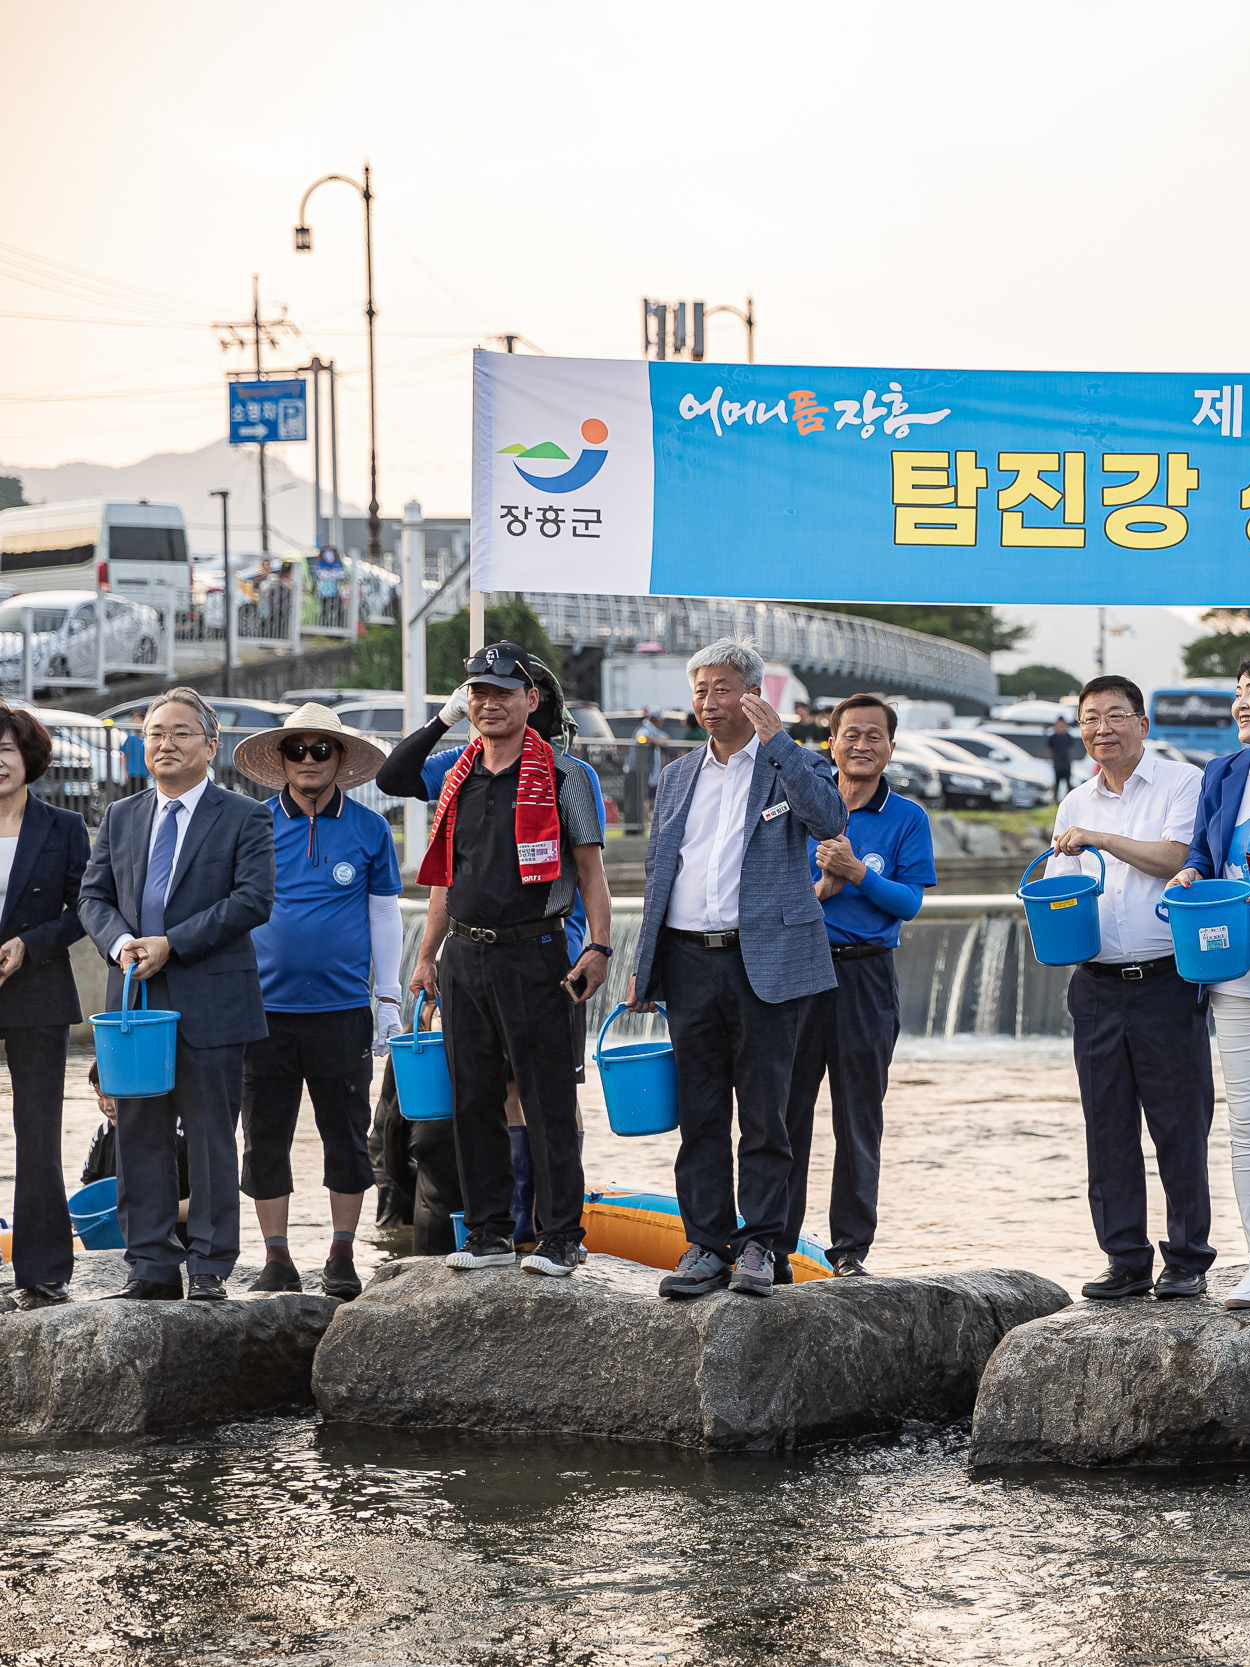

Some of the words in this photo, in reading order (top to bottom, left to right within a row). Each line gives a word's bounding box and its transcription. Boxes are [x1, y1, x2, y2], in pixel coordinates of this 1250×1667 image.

[833, 381, 952, 440] 장흥
[499, 505, 603, 539] 장흥군
[890, 449, 1200, 551] 탐진강
